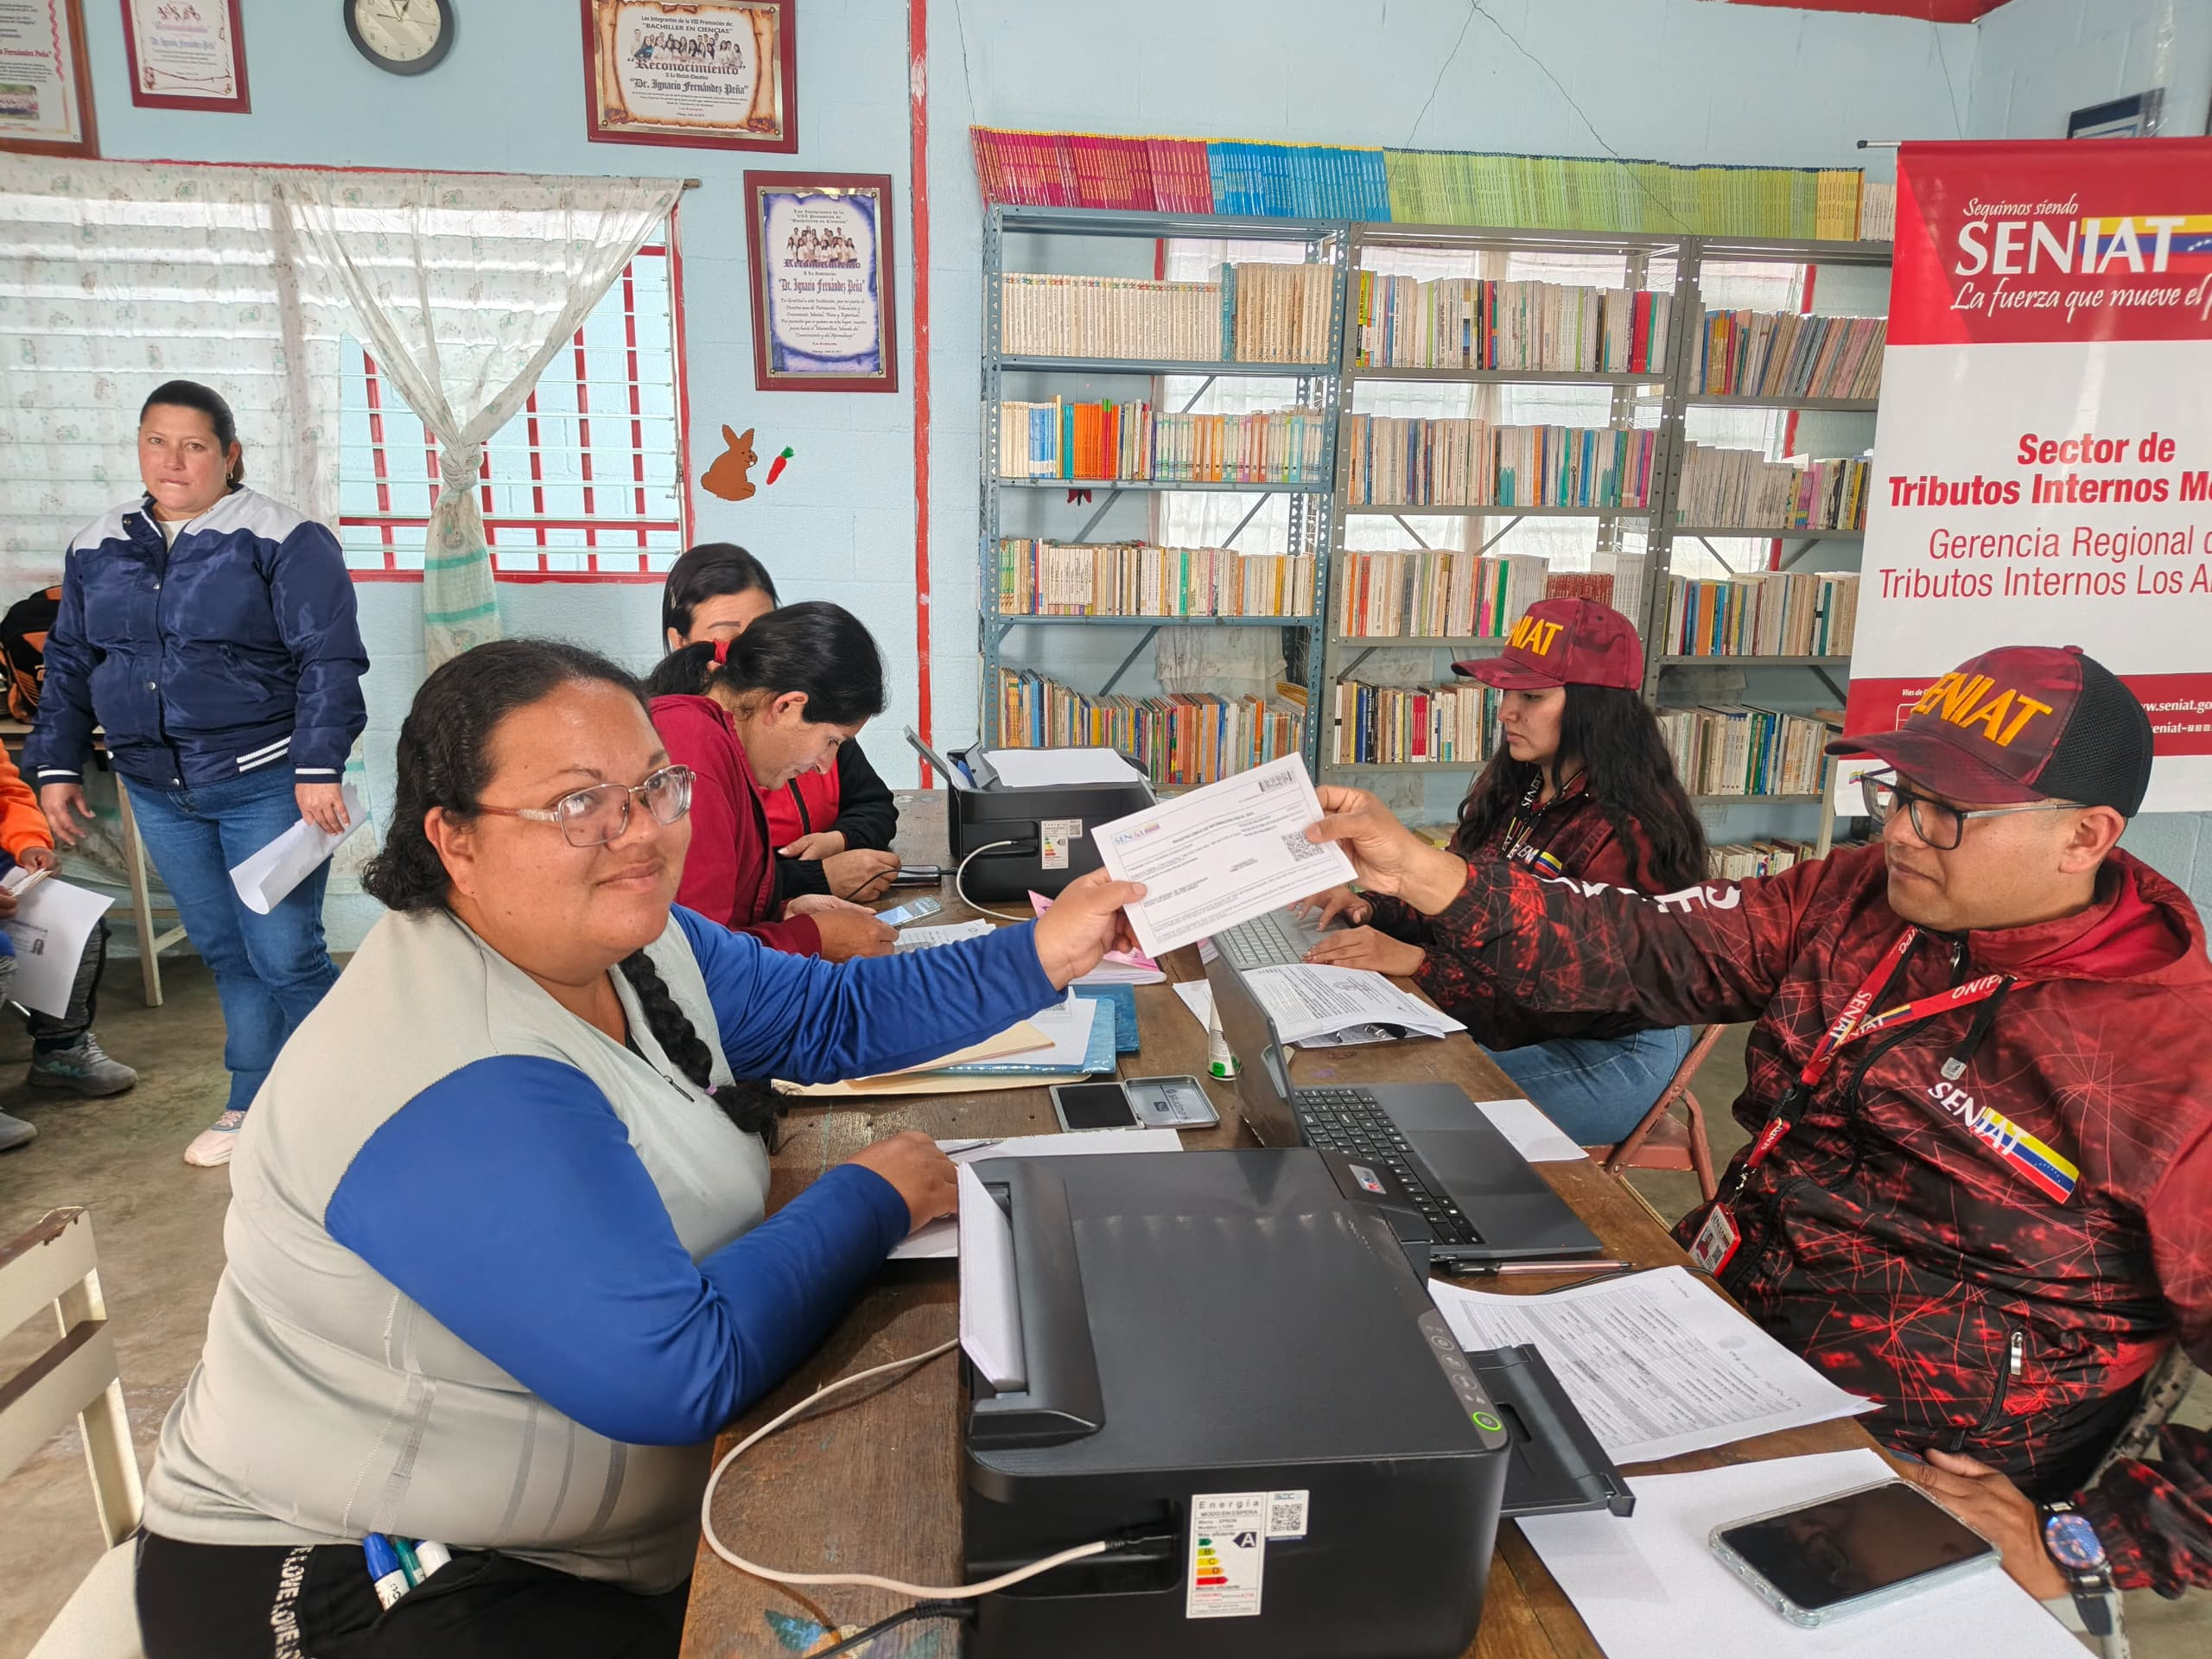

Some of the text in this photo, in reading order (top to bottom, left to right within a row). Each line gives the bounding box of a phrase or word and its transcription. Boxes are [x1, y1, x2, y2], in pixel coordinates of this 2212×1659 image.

[1962, 193, 2079, 222] Seguimos siendo
[1955, 216, 2186, 276] SENIAT
[1950, 274, 2211, 323] La fuerza que mueve el
[2017, 431, 2176, 465] Sector de
[1888, 474, 2021, 506] Tributos
[2031, 472, 2170, 504] Internos
[1929, 526, 2060, 560] Gerencia
[2071, 524, 2195, 563] Regional
[1879, 563, 2212, 599] Tributos Internos Los A
[2140, 698, 2212, 714] w.seniat.go
[1828, 990, 1872, 1038] SENIAT
[1928, 1082, 2031, 1155] SENIAT
[1240, 1533, 1255, 1548] A
